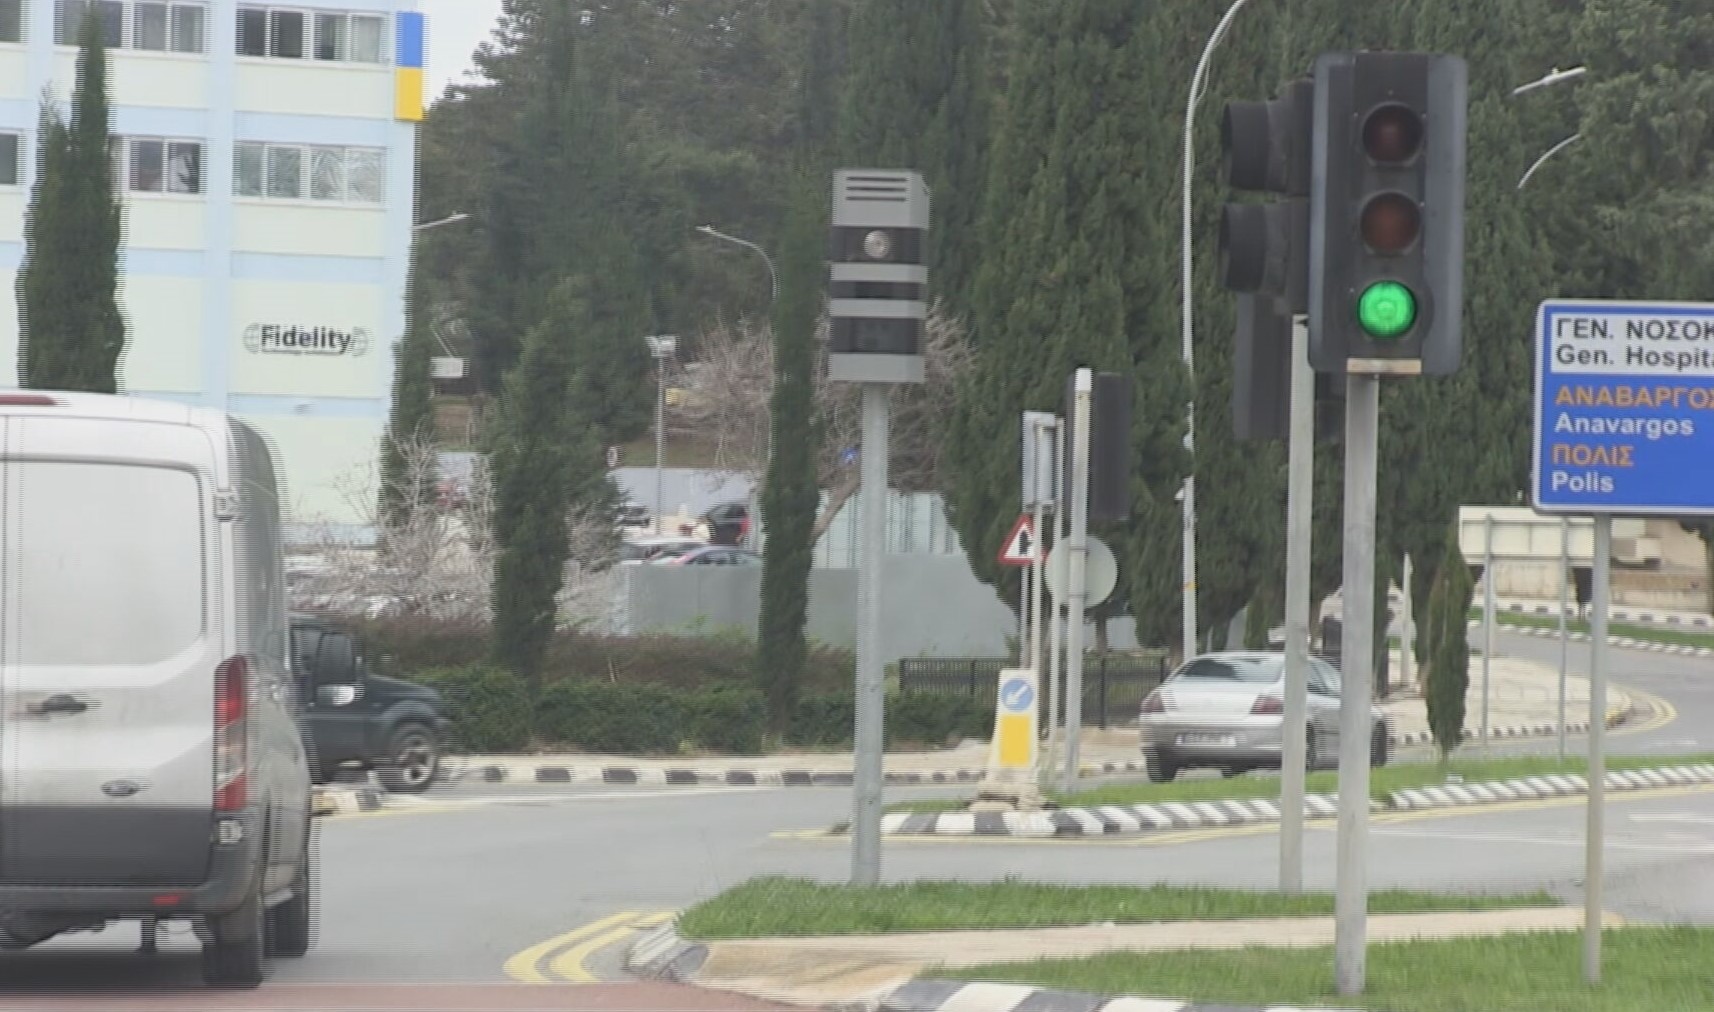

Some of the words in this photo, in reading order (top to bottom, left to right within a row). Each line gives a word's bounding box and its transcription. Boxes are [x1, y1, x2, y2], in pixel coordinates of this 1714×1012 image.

[260, 324, 351, 354] Fidelity
[1556, 317, 1614, 340] ΓΕΝ.
[1556, 343, 1614, 365] Gen.
[1626, 345, 1714, 372] Hospit
[1554, 411, 1694, 440] Anavargos
[1552, 443, 1635, 467] ΠΟΛΙΣ
[1551, 470, 1614, 492] Polis
